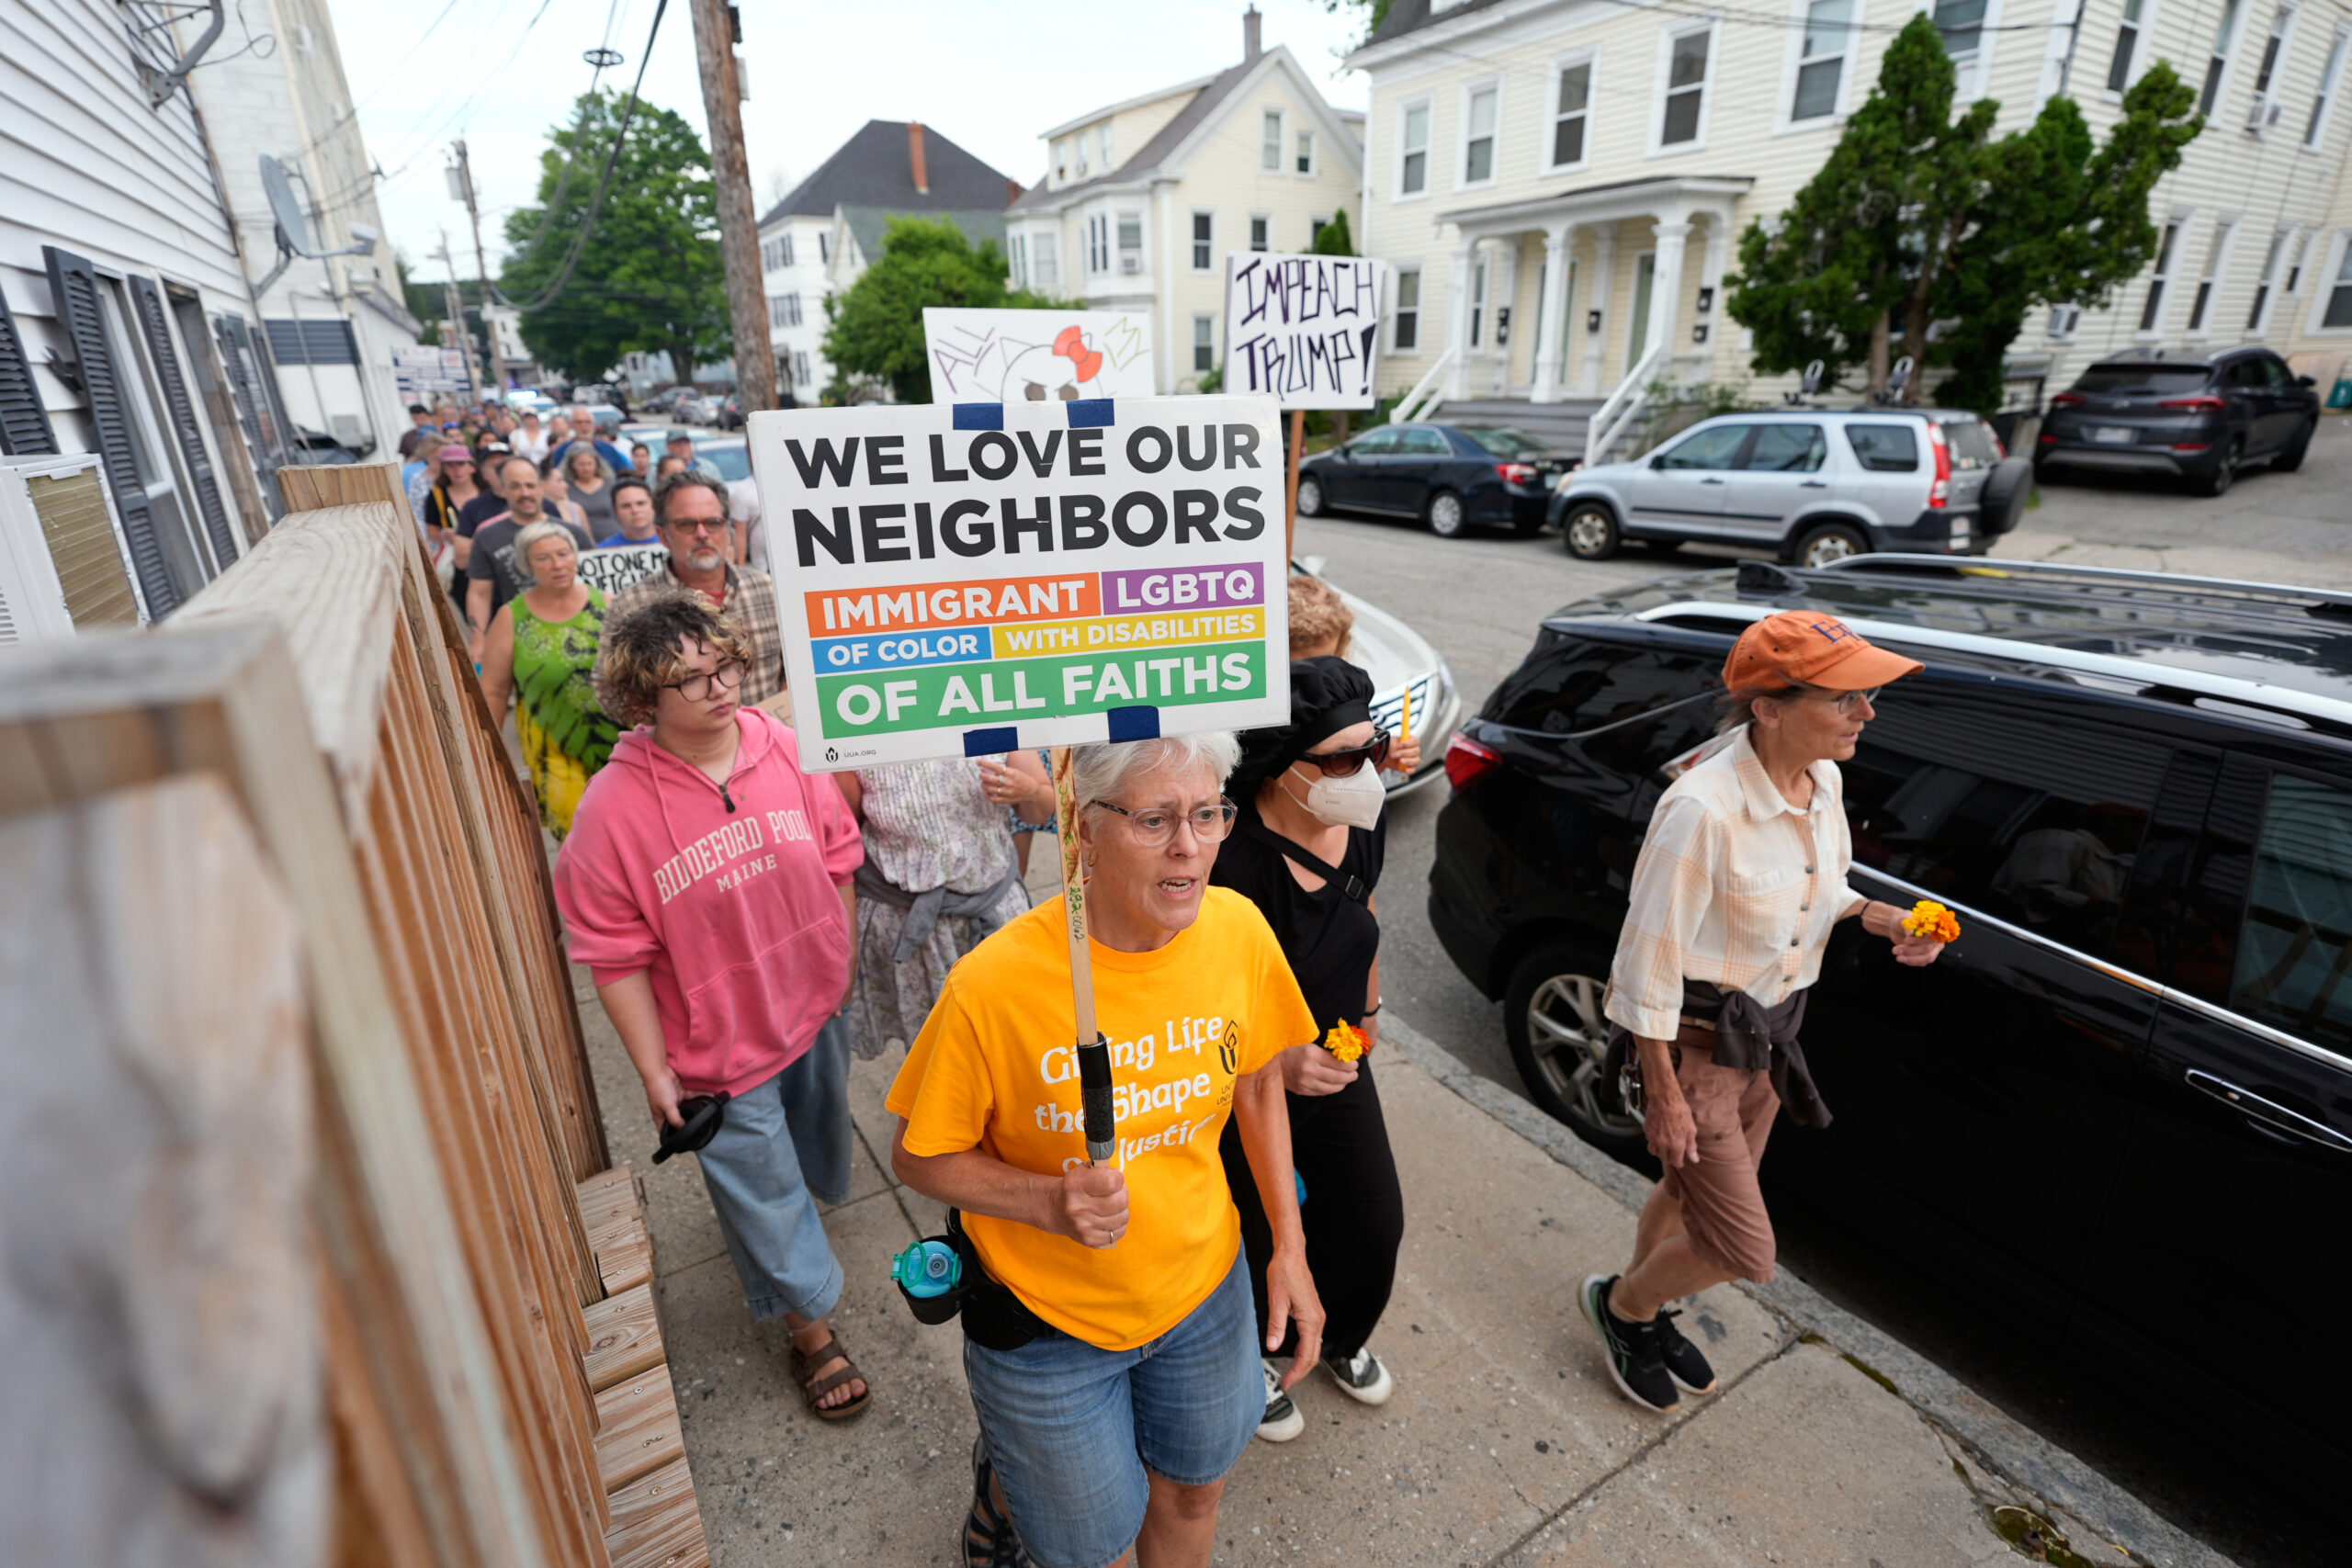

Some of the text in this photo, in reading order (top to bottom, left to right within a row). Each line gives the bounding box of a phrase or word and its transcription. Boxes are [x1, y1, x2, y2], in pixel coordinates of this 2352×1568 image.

[1236, 257, 1377, 326] IMPEACH
[1236, 322, 1377, 401] TRUMP!
[784, 423, 1261, 489] WE LOVE OUR
[792, 486, 1265, 568] NEIGHBORS
[823, 569, 1256, 629] IMMIGRANT LGBTQ
[828, 614, 1256, 666] OF COLOR WITH DISABILITIES
[836, 679, 918, 726] OF
[938, 671, 1046, 716] ALL
[1062, 652, 1253, 705] FAITHS
[843, 749, 876, 758] UUA.ORG
[652, 809, 813, 906] BIDDEFORD POOL
[716, 853, 778, 893] MAINE
[1166, 1016, 1223, 1055] Life
[1113, 1072, 1211, 1123] Shape
